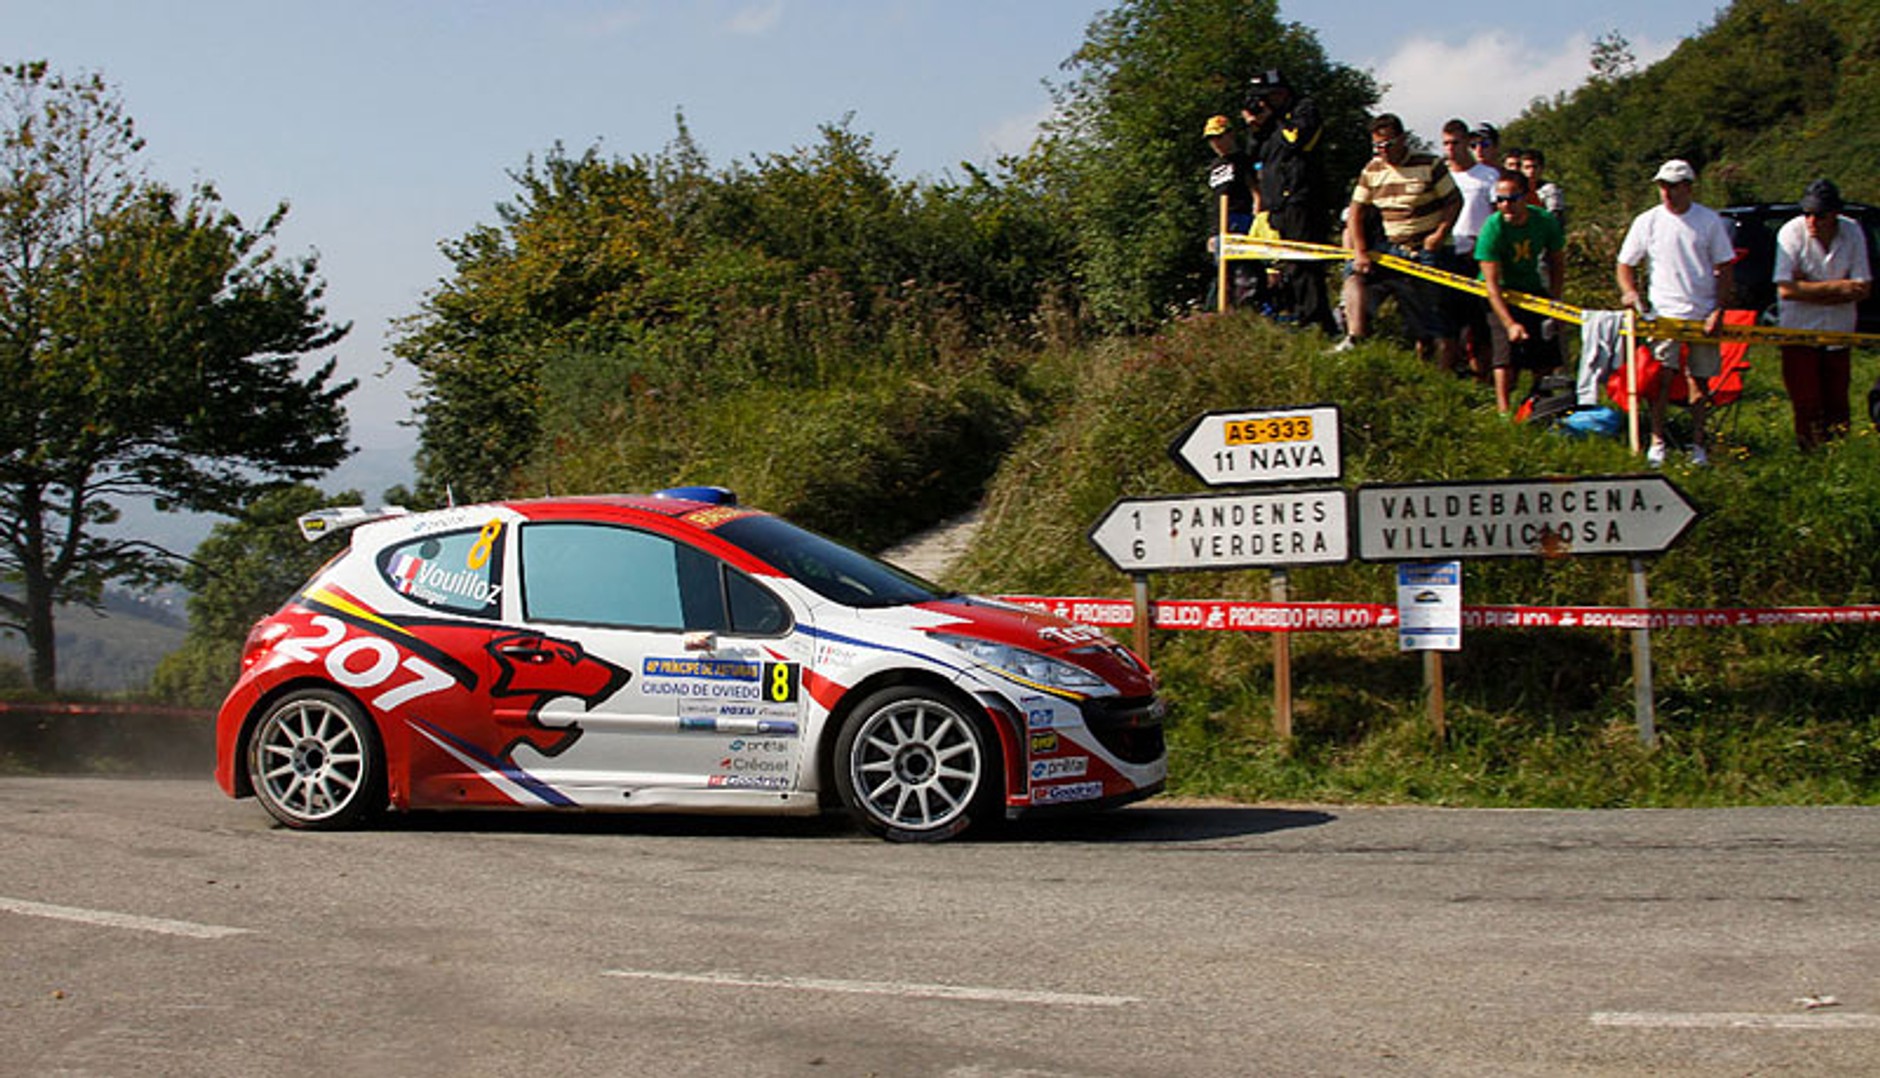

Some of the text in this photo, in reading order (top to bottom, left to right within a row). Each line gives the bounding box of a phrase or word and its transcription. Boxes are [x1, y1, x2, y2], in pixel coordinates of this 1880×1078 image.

[1229, 420, 1310, 441] AS-333
[1213, 446, 1325, 472] 11 NAVA
[1132, 502, 1326, 530] 1 PANDENES
[1382, 489, 1663, 519] VALDEBARCENA,
[467, 517, 501, 571] 8
[1132, 532, 1327, 560] 6 VERDERA
[418, 562, 502, 605] Vouilloz
[1073, 603, 1134, 623] PROHIBID
[1228, 606, 1303, 628] PROHIBIDO
[272, 615, 456, 712] 207
[642, 682, 760, 699] CIUDAD DE OVIEDO
[772, 663, 789, 702] 8
